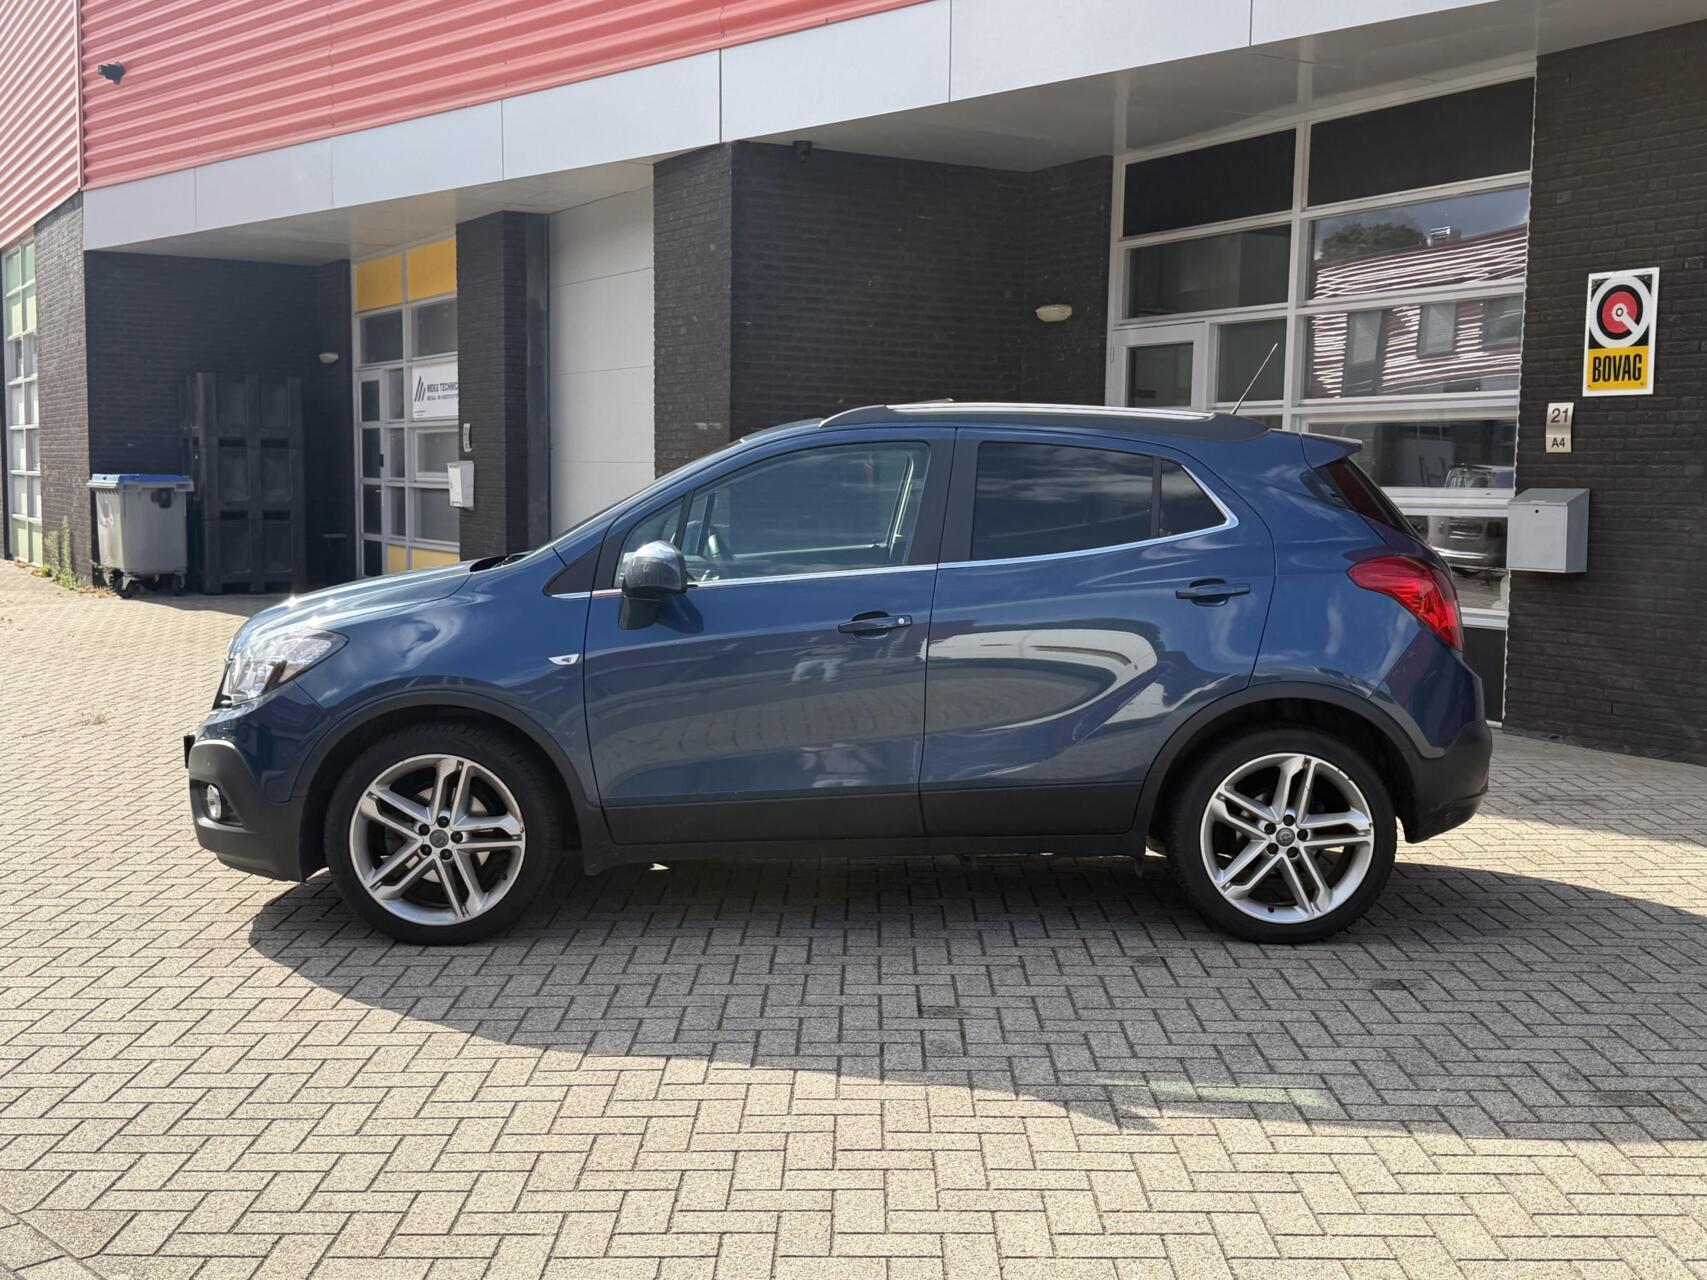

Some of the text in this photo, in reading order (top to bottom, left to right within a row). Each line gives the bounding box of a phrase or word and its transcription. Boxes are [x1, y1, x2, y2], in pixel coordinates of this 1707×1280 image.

[1592, 353, 1642, 383] BOVAG
[1550, 408, 1569, 424] 21
[1551, 437, 1566, 448] A4
